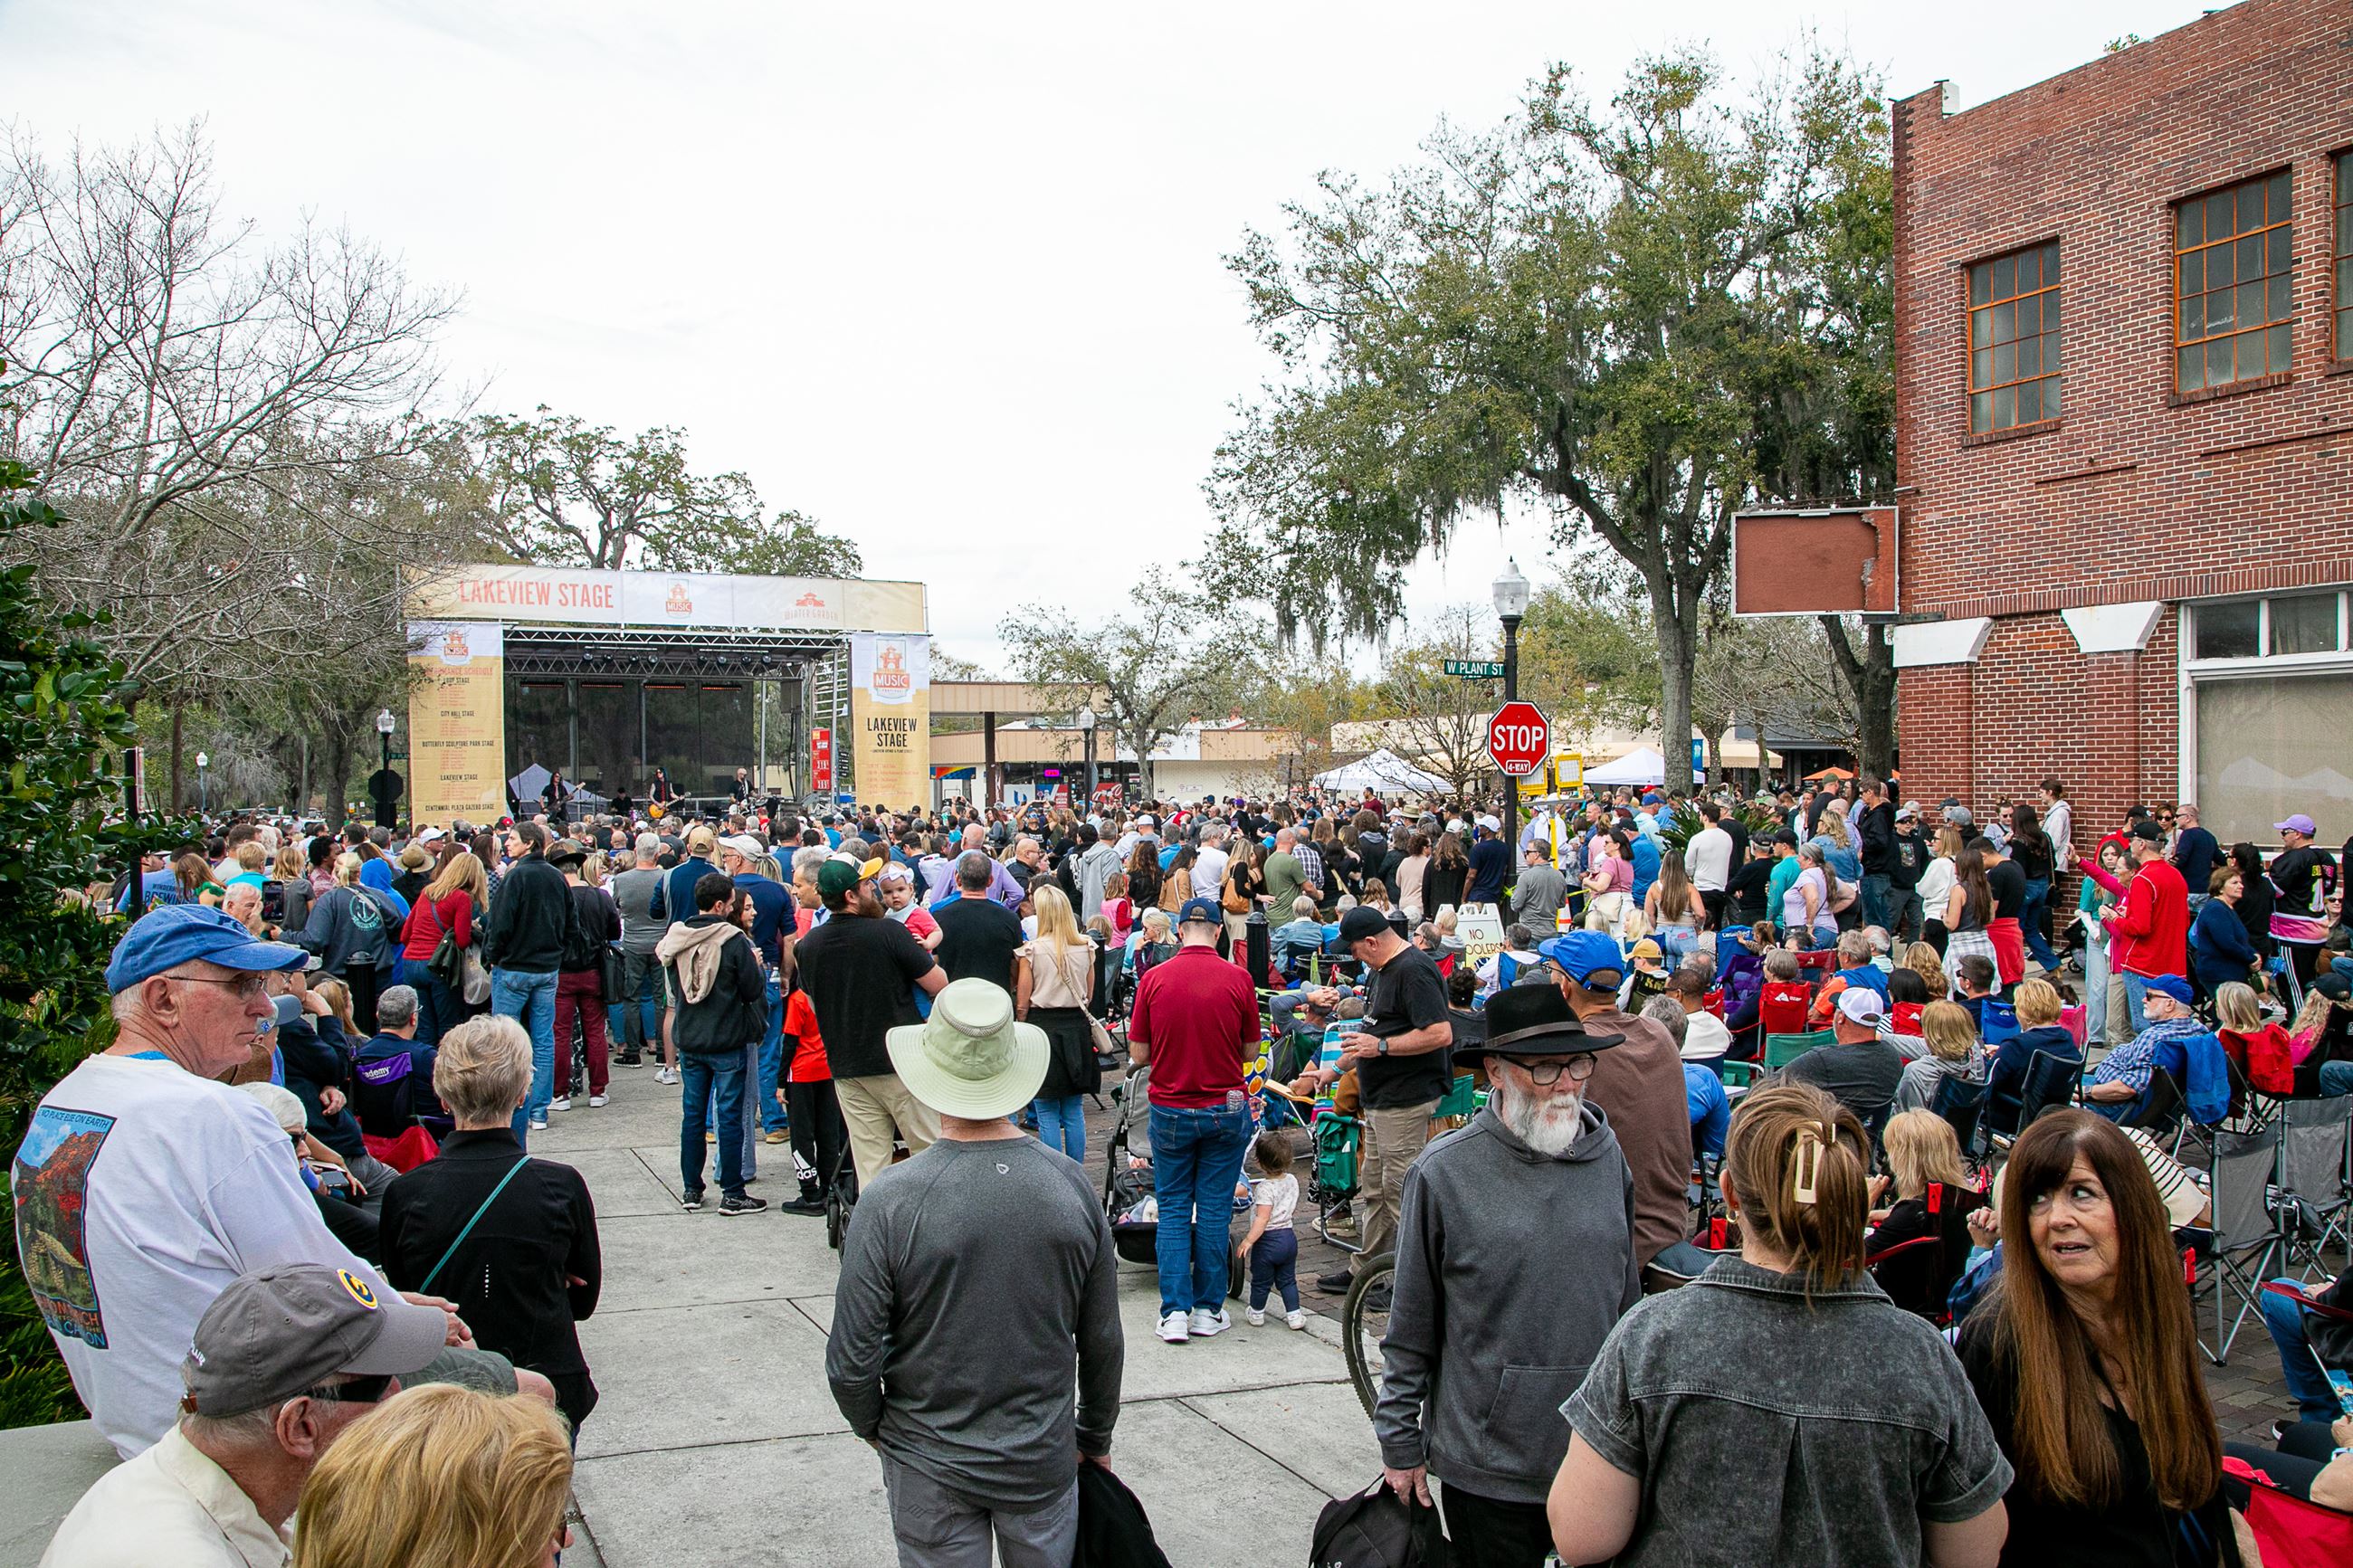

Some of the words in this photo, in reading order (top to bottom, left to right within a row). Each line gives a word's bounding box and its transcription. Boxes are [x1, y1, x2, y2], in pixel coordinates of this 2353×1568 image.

[460, 580, 550, 606] LAKEVIEW
[558, 583, 614, 608] STAGE
[667, 602, 691, 612] MUSIC
[784, 608, 810, 620] WINTER
[813, 608, 838, 622] GARDEN
[444, 647, 468, 655] MUSIC
[1447, 661, 1456, 673] W
[1460, 662, 1489, 675] PLANT
[1491, 663, 1503, 675] ST
[875, 674, 908, 688] MUSIC
[867, 717, 917, 731] LAKEVIEW
[877, 734, 908, 746] STAGE
[1493, 725, 1544, 752] STOP
[1508, 763, 1529, 773] 4-WAY
[1468, 928, 1484, 940] NO
[1464, 943, 1500, 955] OOLERS
[75, 1114, 86, 1124] ON
[85, 1116, 109, 1129] EARTH
[796, 1166, 817, 1180] das
